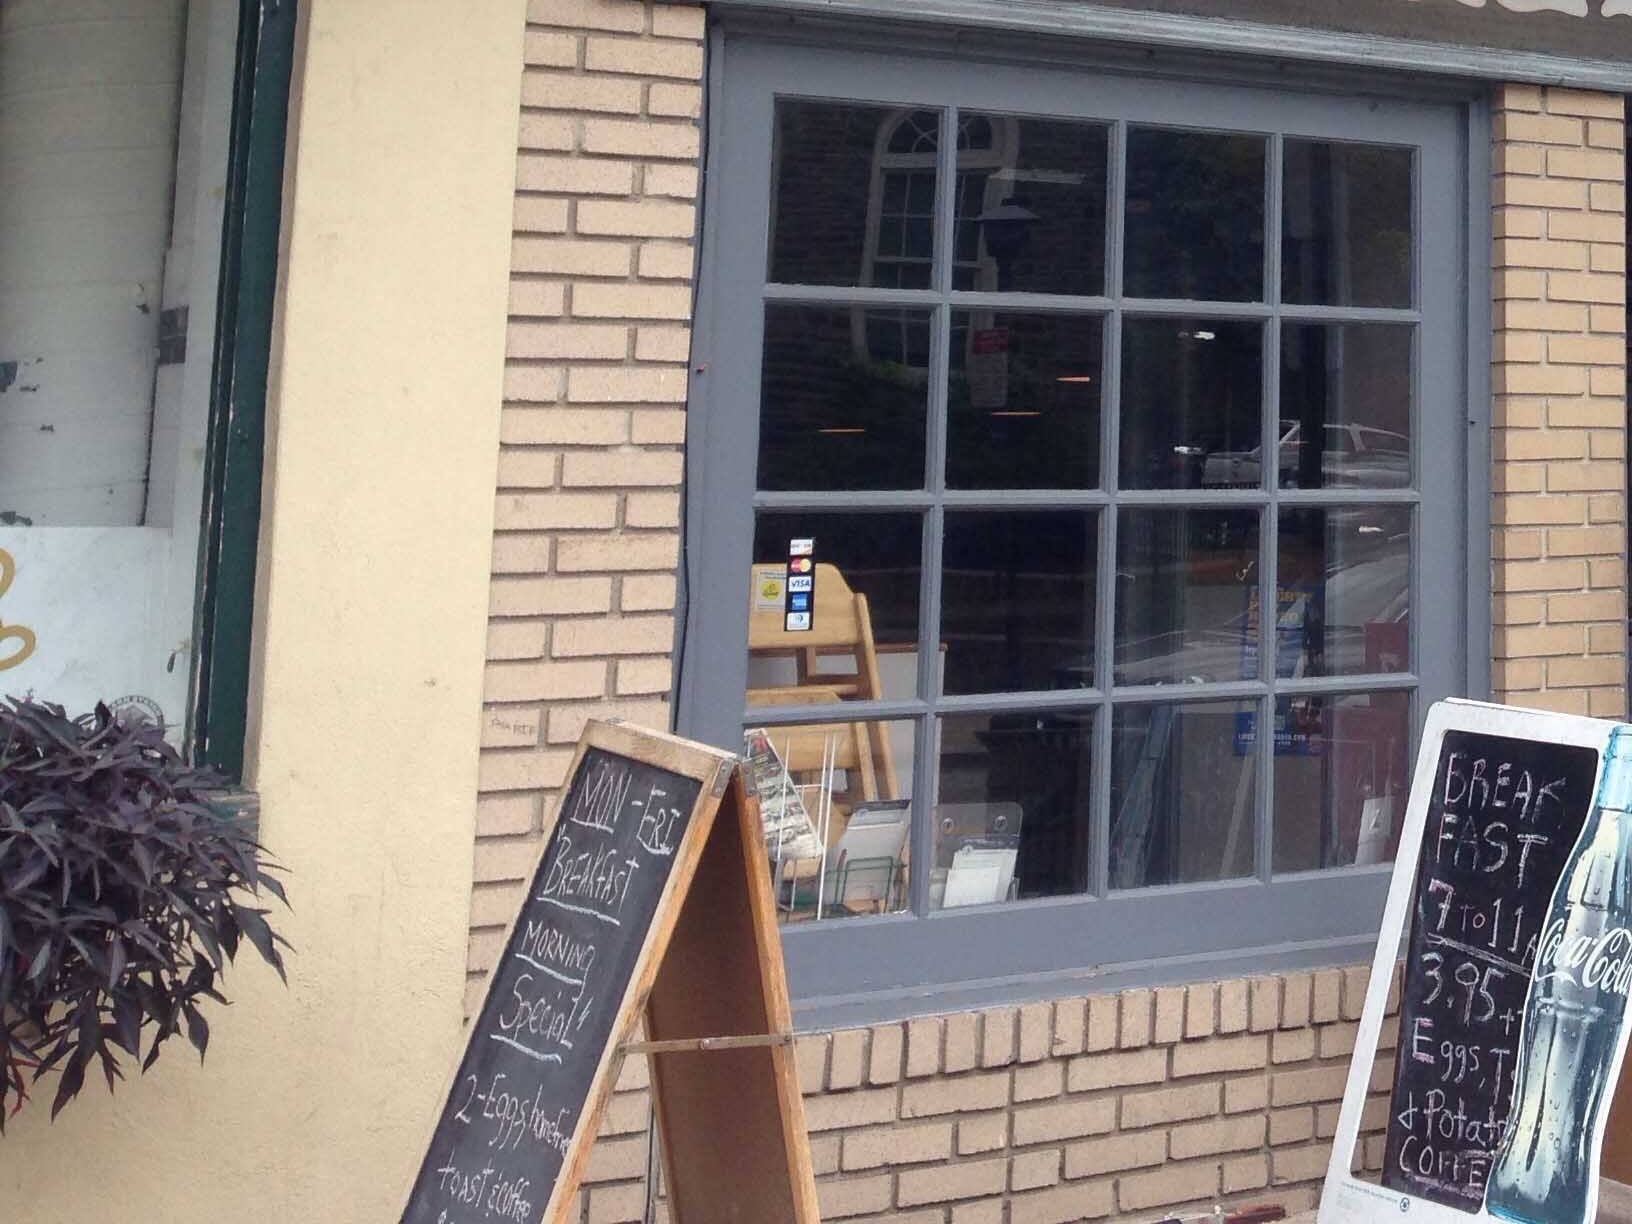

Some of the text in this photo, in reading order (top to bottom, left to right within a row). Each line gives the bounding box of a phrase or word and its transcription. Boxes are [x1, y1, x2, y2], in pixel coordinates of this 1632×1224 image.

[791, 580, 811, 588] VISA
[1444, 752, 1567, 823] BREAK
[1436, 812, 1549, 889] FAST
[1428, 878, 1456, 931] 7
[1421, 952, 1506, 1027] 3.95
